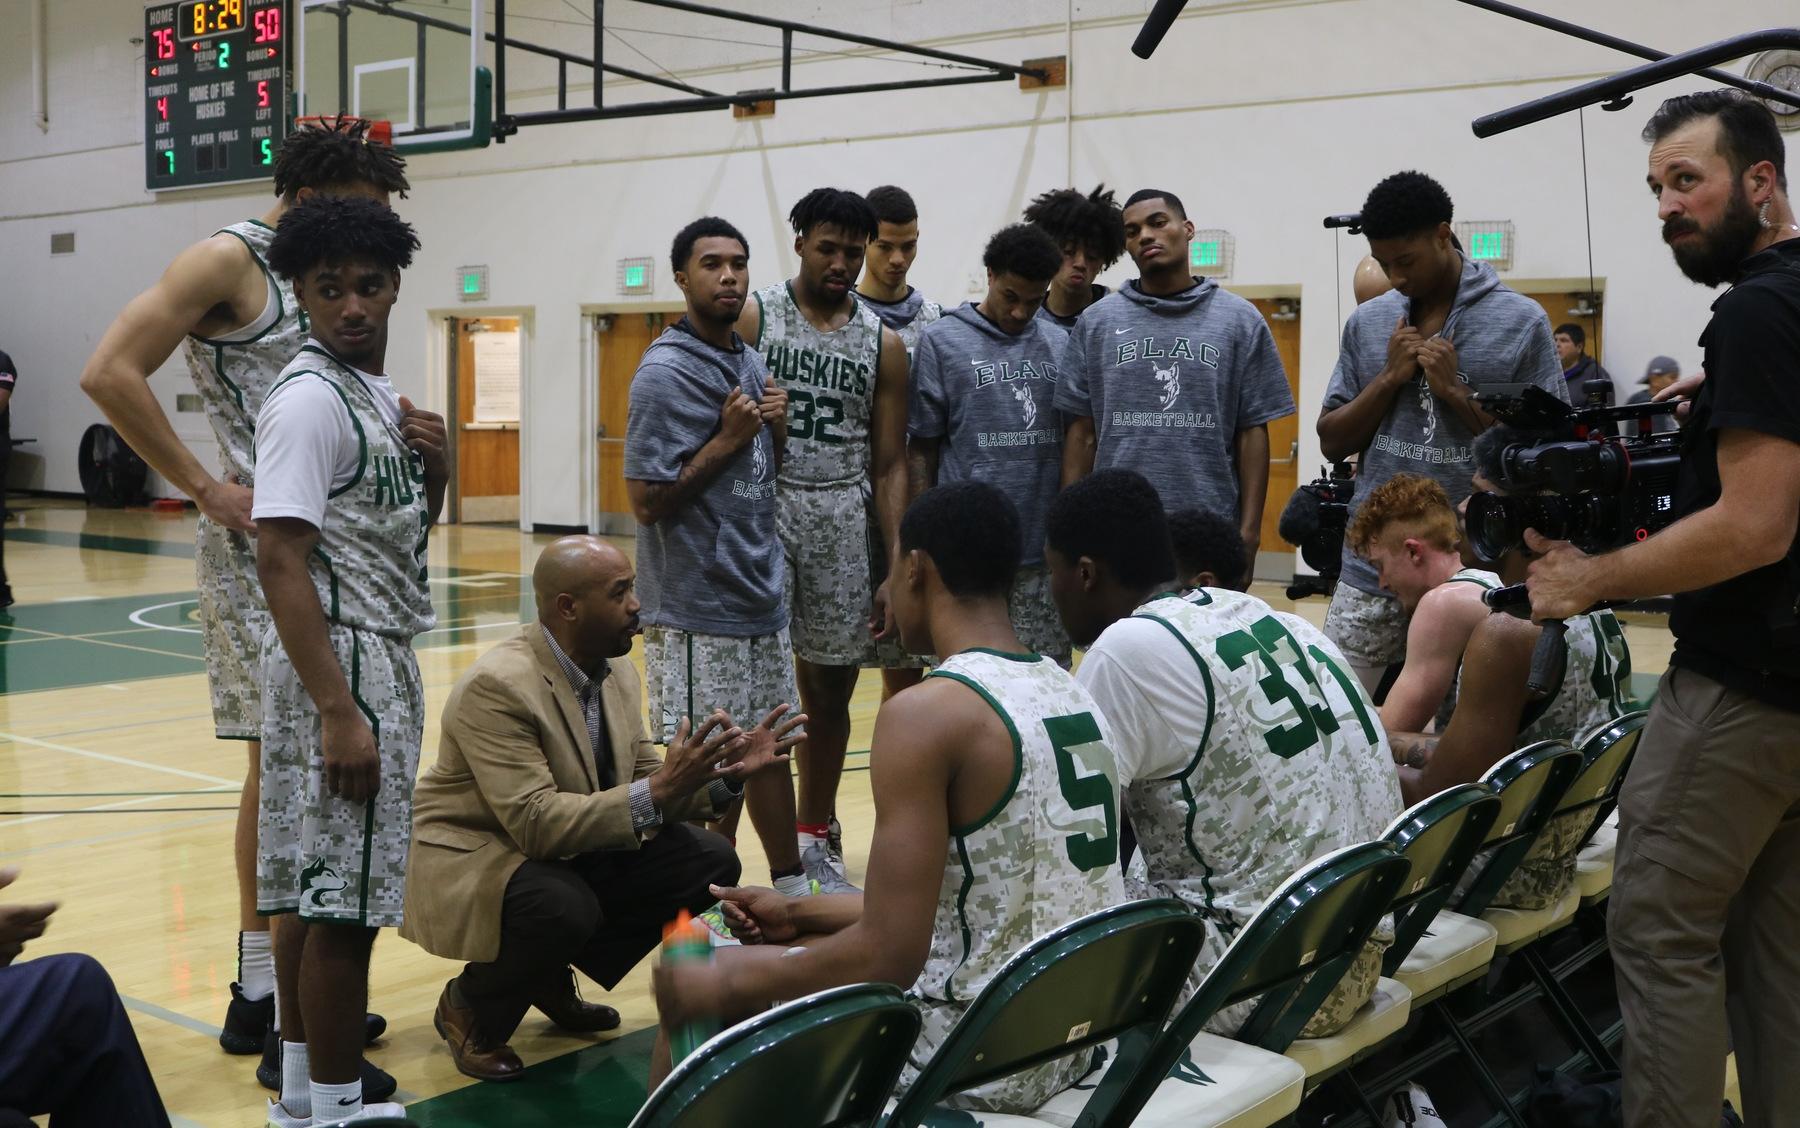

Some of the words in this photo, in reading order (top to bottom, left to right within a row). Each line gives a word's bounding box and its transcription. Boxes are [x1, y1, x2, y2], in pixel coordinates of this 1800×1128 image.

[150, 8, 174, 25] HOME
[194, 0, 241, 34] 8:29
[254, 8, 279, 42] 50
[152, 28, 175, 59] 75
[219, 42, 229, 68] 2
[158, 63, 178, 77] BONUS
[247, 67, 280, 82] TIMEOUTS
[148, 83, 178, 97] TIMEOUTS
[189, 85, 209, 102] HOME
[210, 83, 219, 99] OF
[221, 80, 235, 97] THE
[257, 81, 269, 107] 5
[157, 96, 168, 120] 4
[196, 101, 226, 120] HUSKIES
[255, 108, 271, 120] LEFT
[155, 121, 170, 134] LEFT
[191, 133, 214, 146] PLAYER
[218, 130, 239, 143] FOULS
[251, 126, 272, 138] FOULS
[155, 138, 174, 150] FOULS
[261, 139, 273, 165] 5
[165, 151, 175, 175] 7
[1471, 231, 1504, 259] EXIT
[1115, 336, 1220, 370] ELAC
[766, 344, 870, 397] HUSKIES
[975, 359, 1059, 390] ELAC
[786, 389, 844, 443] 32
[1112, 411, 1216, 428] BASKETBALL
[1042, 711, 1117, 873] 5
